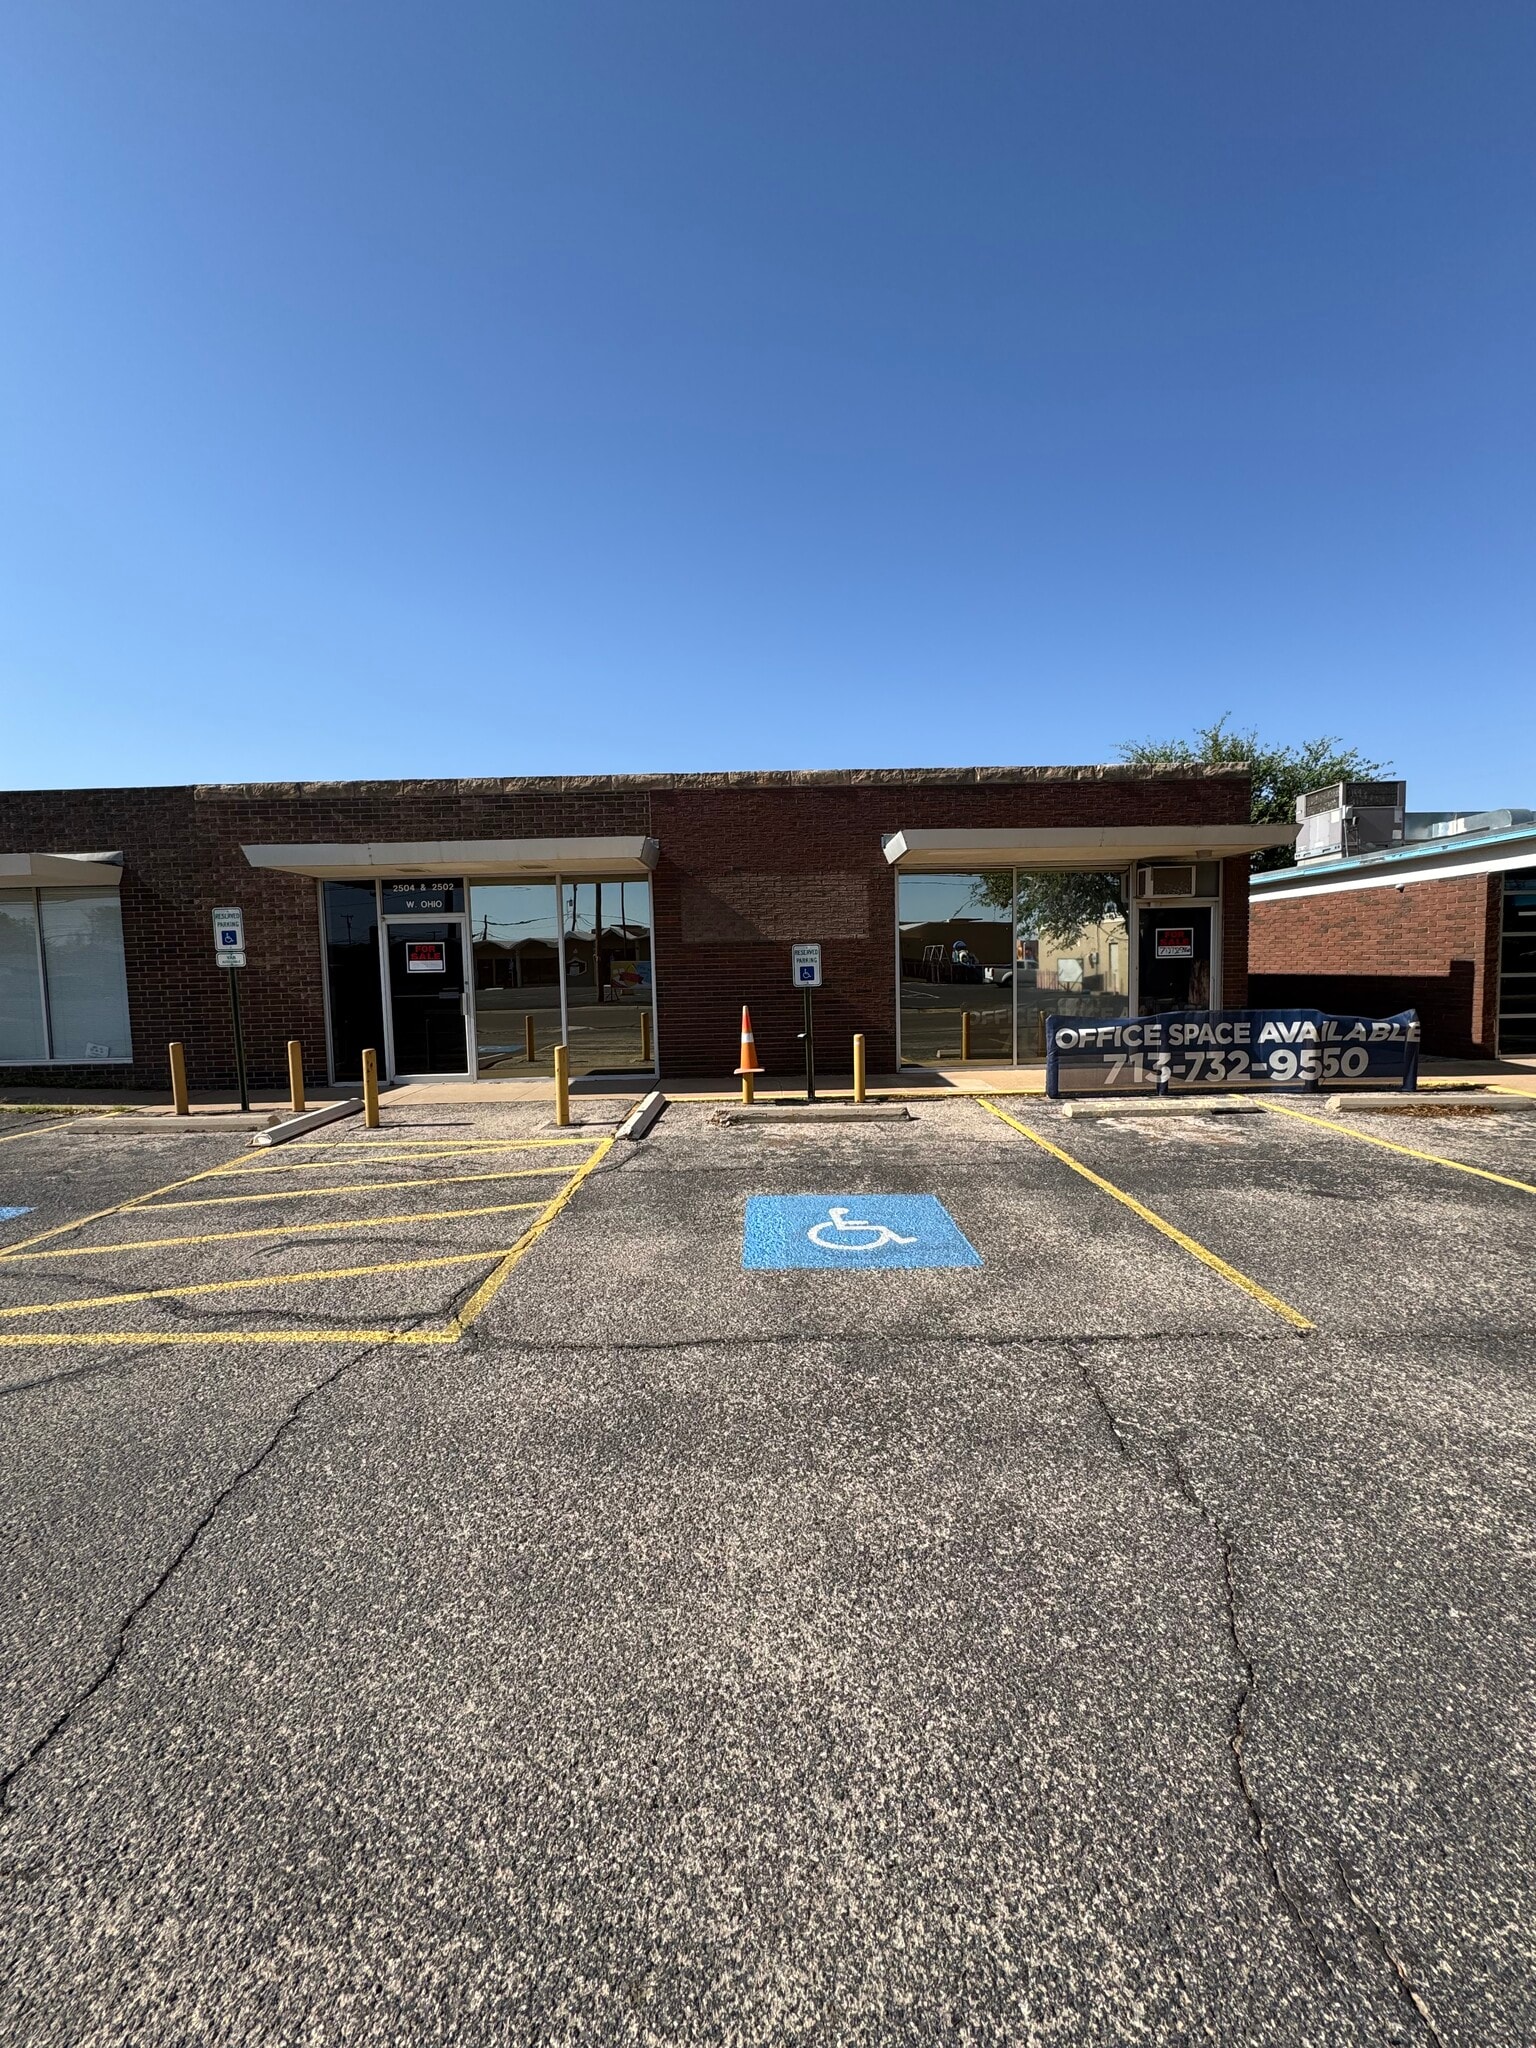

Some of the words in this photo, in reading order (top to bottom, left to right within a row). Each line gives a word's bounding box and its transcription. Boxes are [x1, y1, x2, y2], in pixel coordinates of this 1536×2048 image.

[432, 883, 454, 891] 2502
[420, 900, 443, 908] OHIO
[410, 952, 441, 960] SALE
[1055, 1023, 1162, 1050] OFFICE
[1168, 1022, 1251, 1046] SPACE
[1257, 1020, 1422, 1044] AVAILABLE
[1103, 1046, 1370, 1085] 713-732-9550
